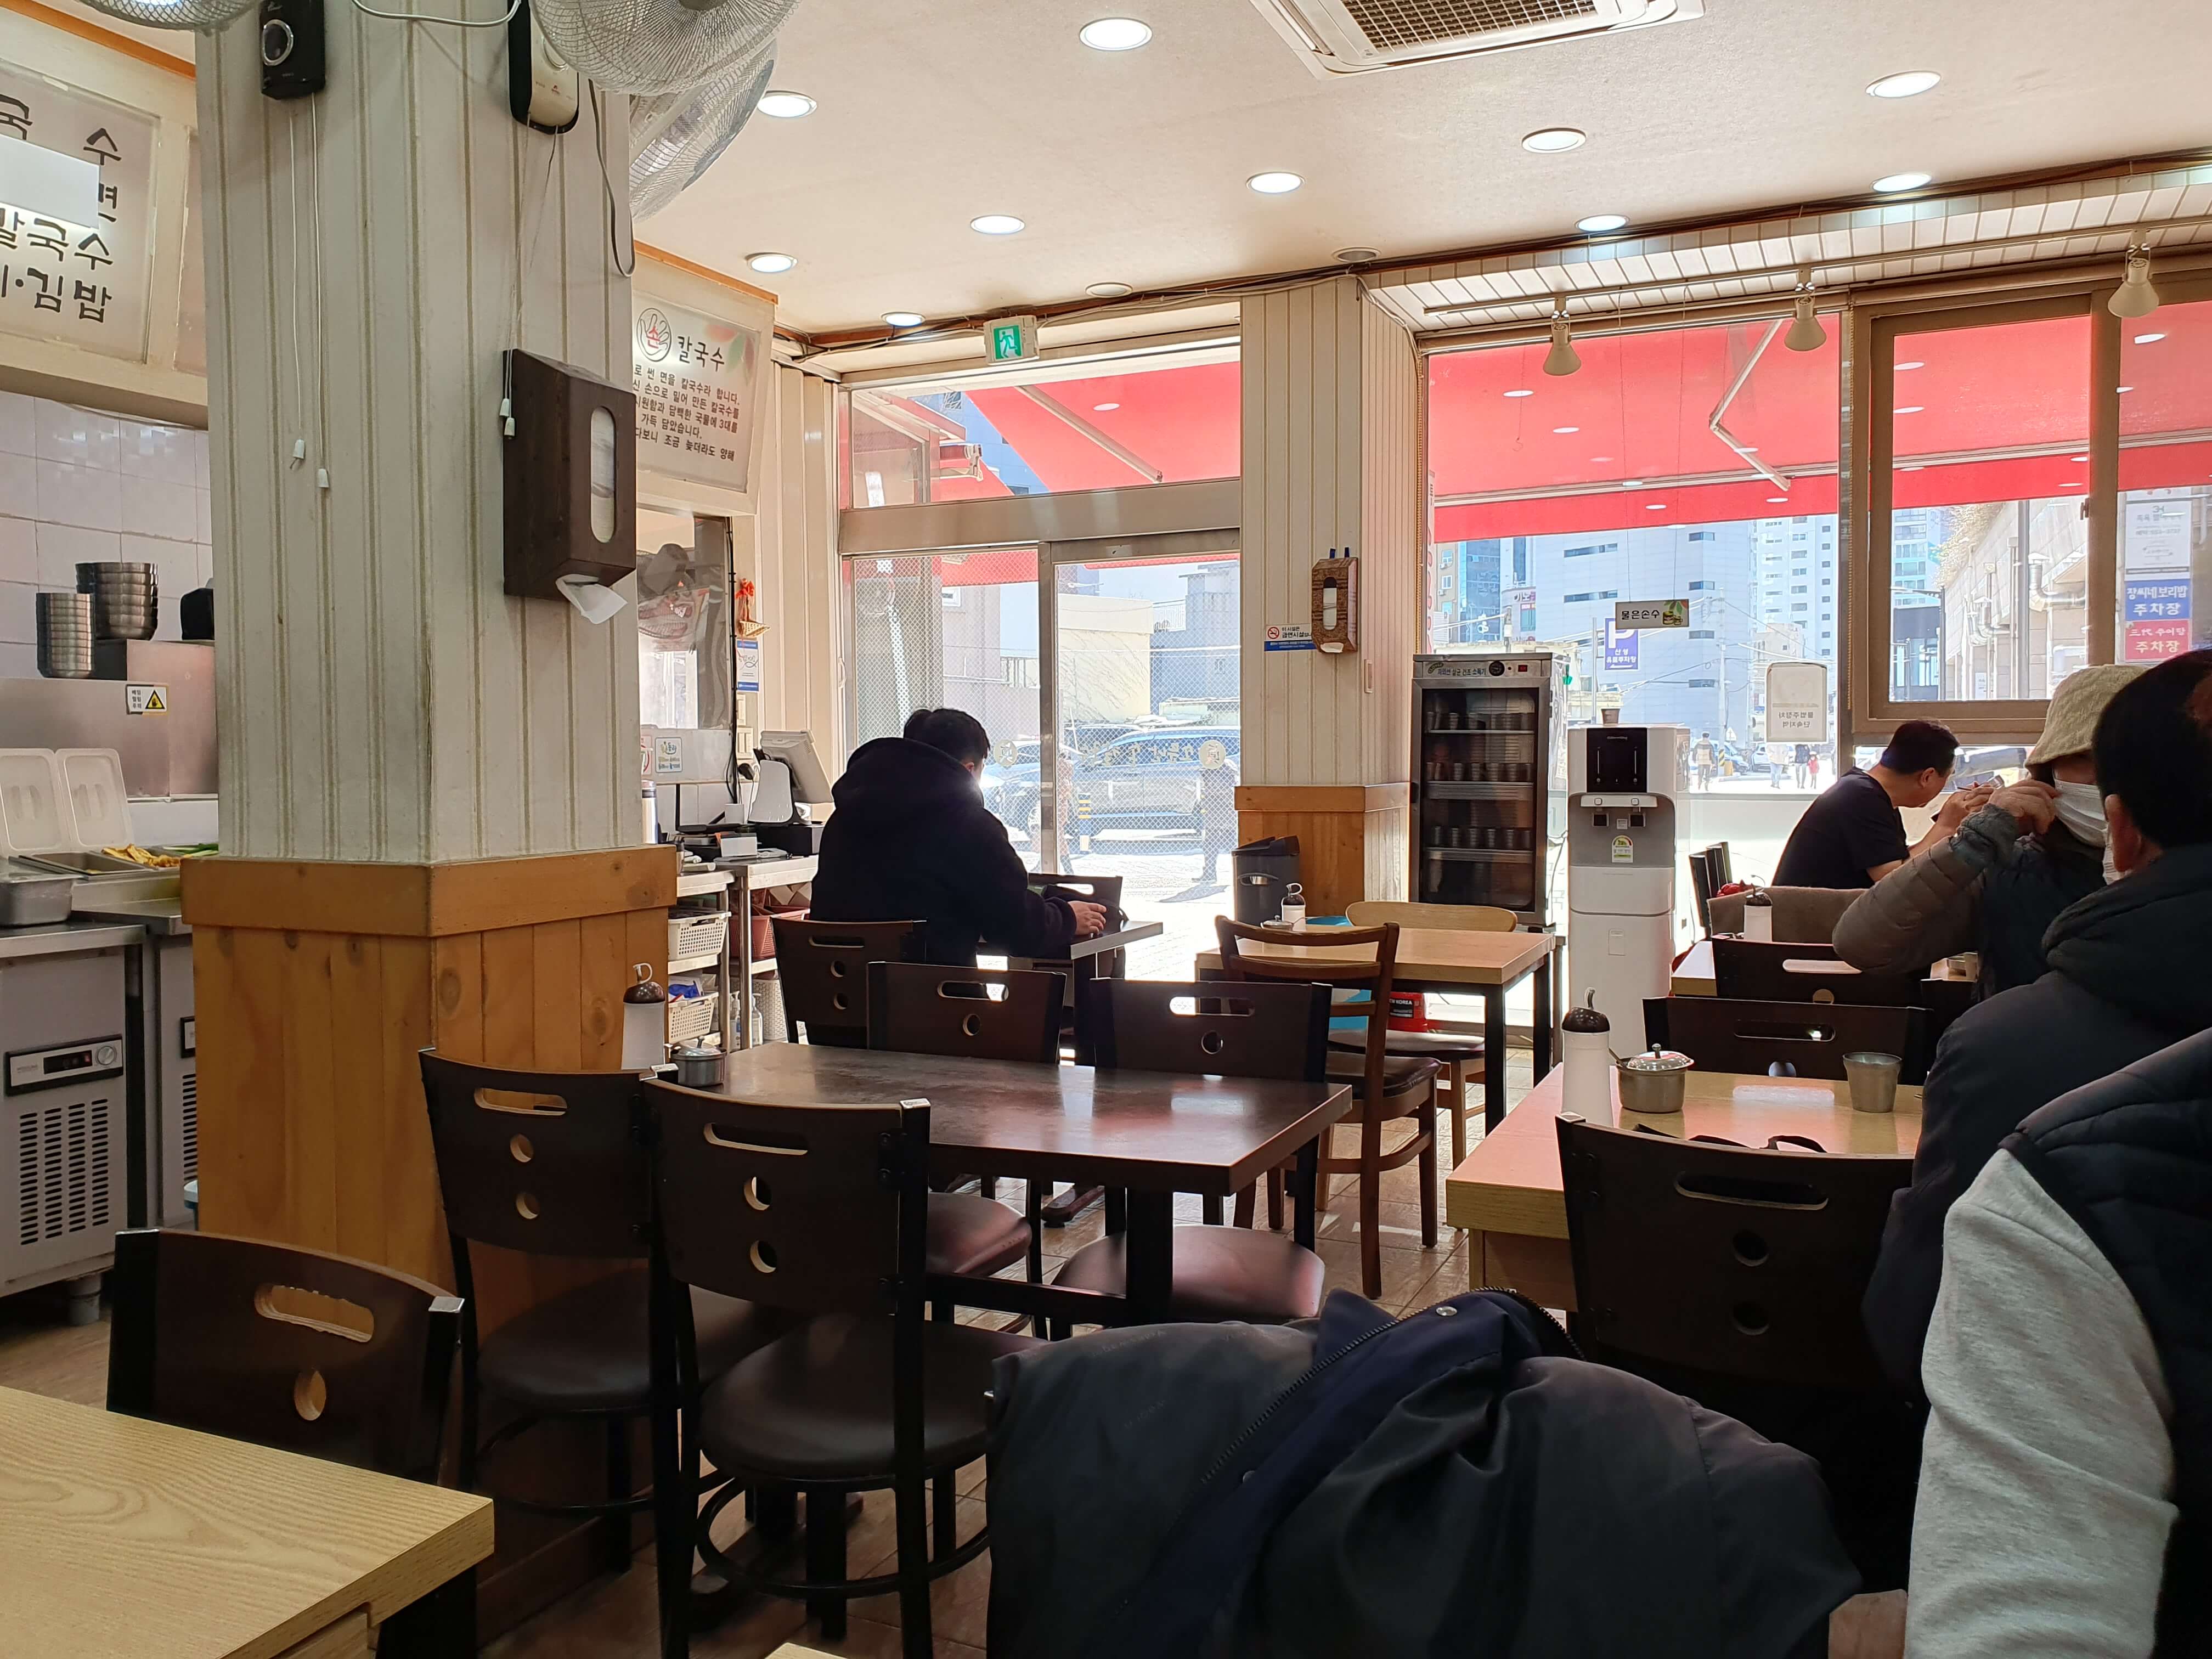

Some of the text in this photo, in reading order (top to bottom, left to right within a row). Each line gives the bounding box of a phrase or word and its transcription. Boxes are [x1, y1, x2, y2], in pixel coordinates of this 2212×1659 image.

[678, 335, 725, 372] 칼국수
[647, 368, 655, 380] 썬
[660, 371, 675, 386] 면을
[682, 378, 711, 397] 칼국수라
[716, 388, 740, 405] 합니다.
[645, 382, 668, 399] 손으로
[673, 391, 688, 405] 밀어
[692, 396, 707, 410] 만든
[711, 402, 739, 419] 칼국수를
[641, 414, 702, 439] 가득 담았습니다.
[669, 405, 691, 421] 담백한
[695, 412, 717, 428] 국물에
[719, 419, 738, 433] 3대를
[664, 435, 680, 448] 조금
[686, 439, 715, 456] 늦더라도
[720, 448, 735, 461] 양해
[2133, 602, 2181, 616] 주차장
[2136, 640, 2180, 653] 주차장
